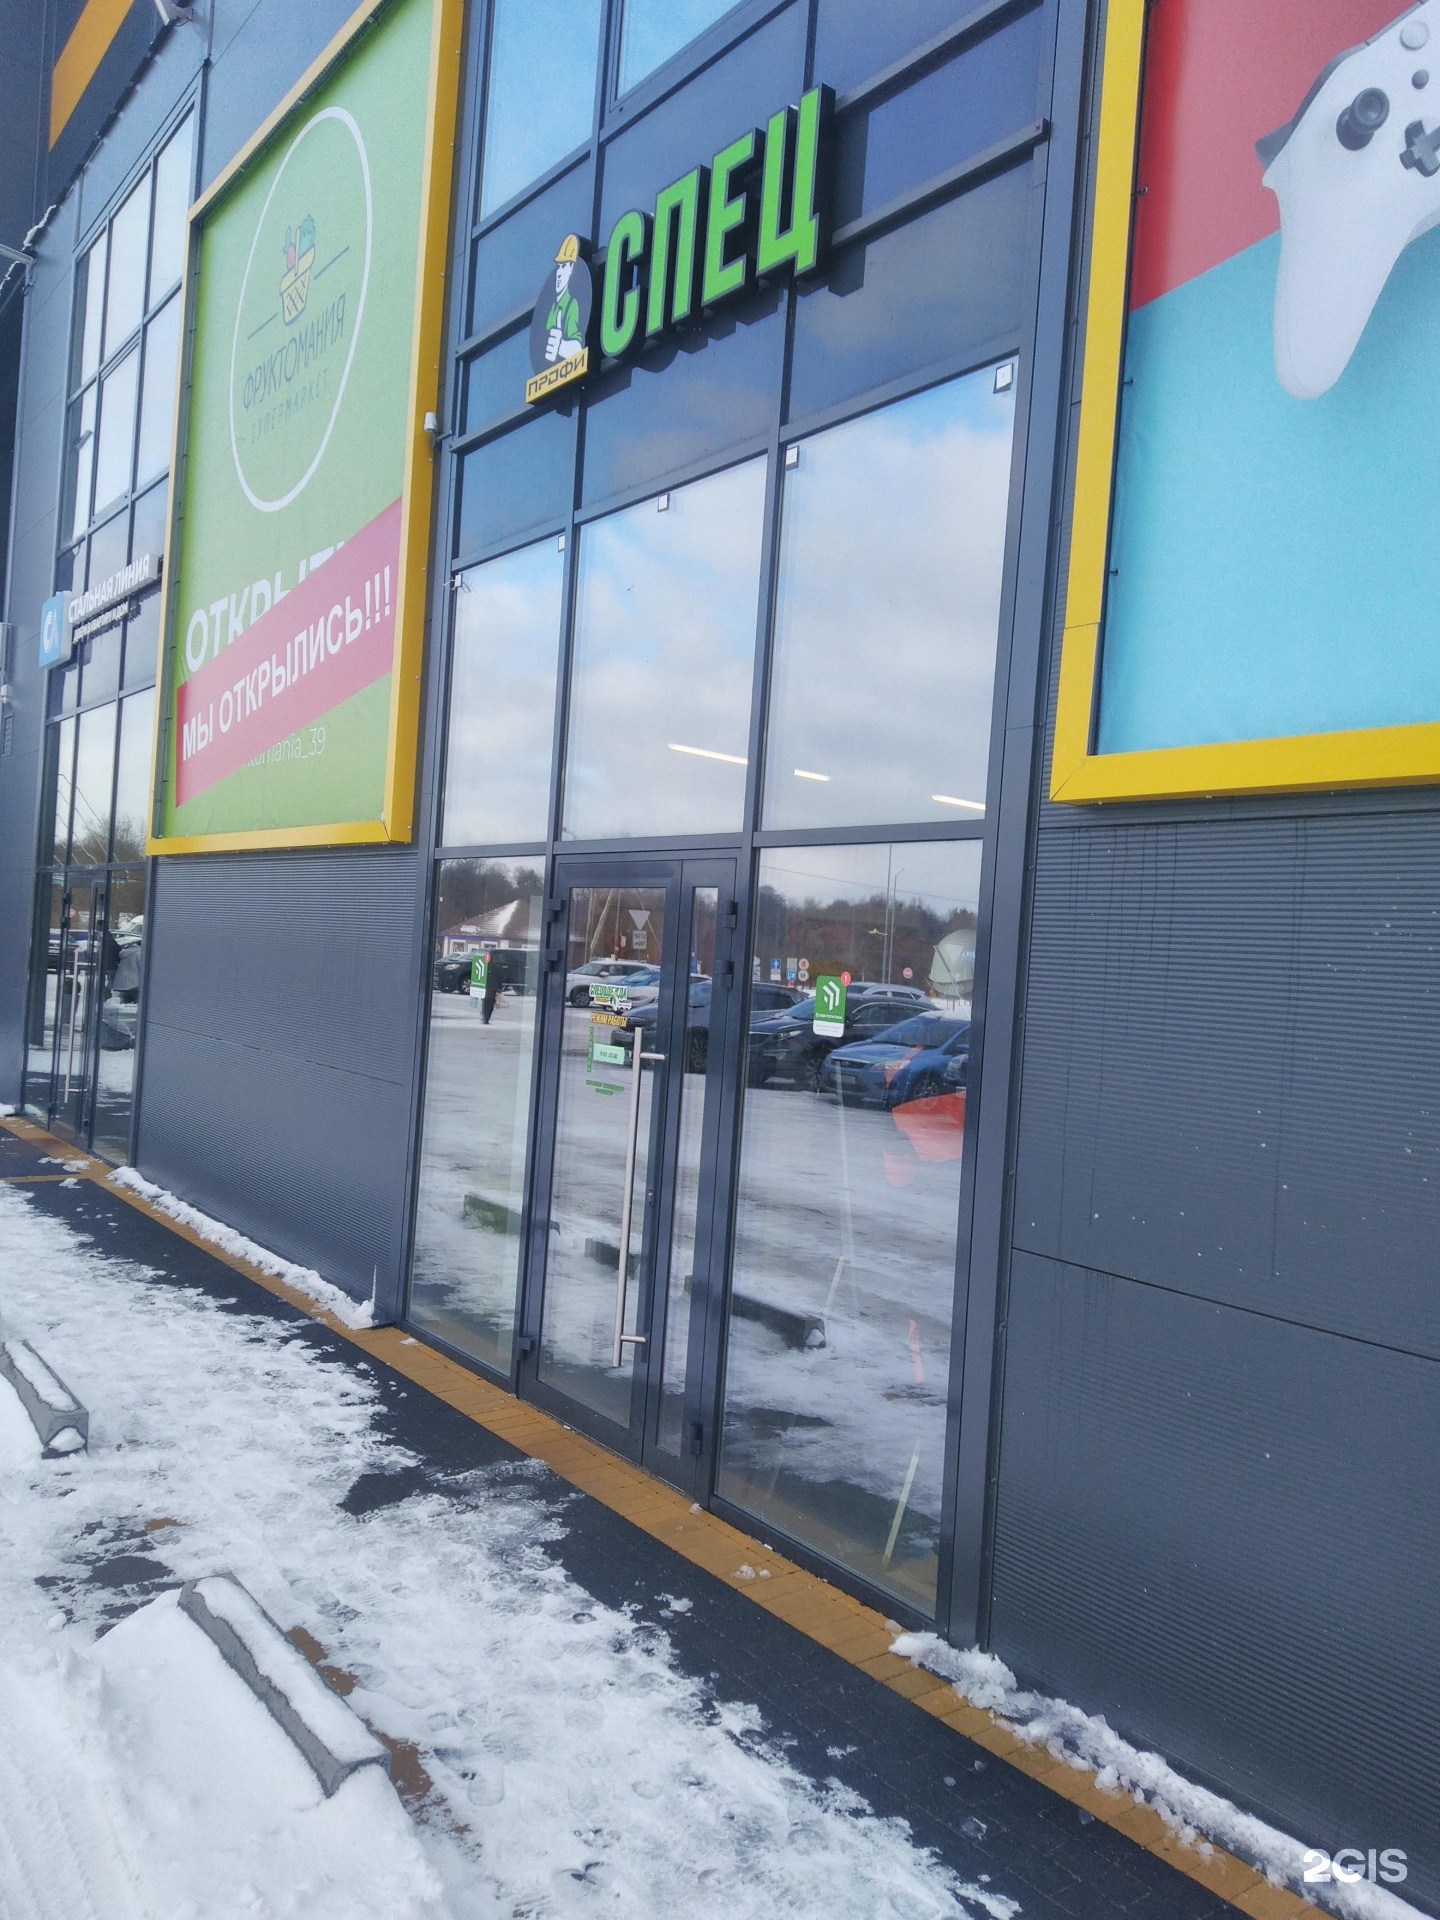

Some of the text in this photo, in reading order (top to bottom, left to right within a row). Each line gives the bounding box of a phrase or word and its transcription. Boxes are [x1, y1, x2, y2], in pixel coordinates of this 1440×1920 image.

[600, 84, 822, 357] СПЕЦ
[243, 292, 346, 412] ФРУКТОМАНИЯ
[528, 353, 585, 396] ПРОФИ
[251, 367, 328, 444] СУПЕРМАРКЕТ
[68, 553, 149, 623] СТАЛЬНАЯ ЛИНИЯ
[183, 565, 391, 762] МЫ ОТКРЫЛИСЬ!!!
